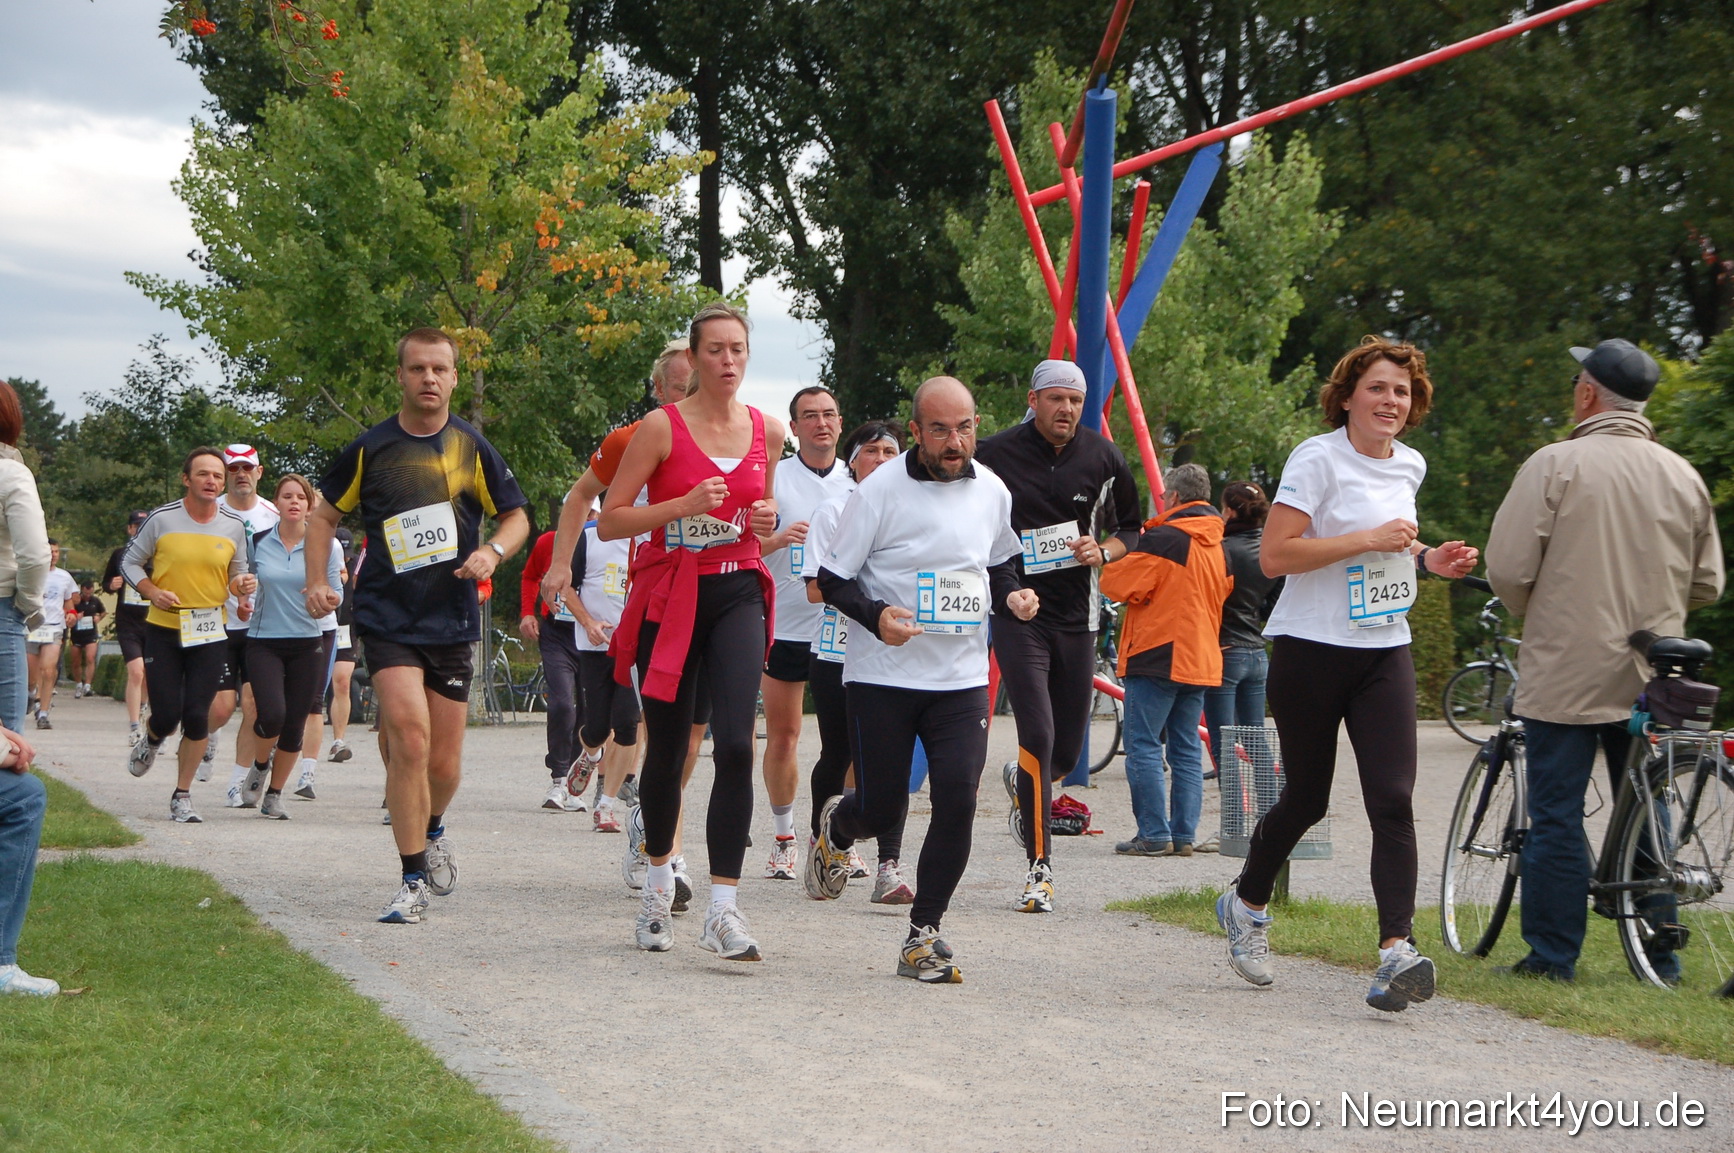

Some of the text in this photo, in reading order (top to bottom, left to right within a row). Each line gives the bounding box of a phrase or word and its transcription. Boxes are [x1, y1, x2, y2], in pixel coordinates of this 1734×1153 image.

[401, 515, 420, 529] Olaf
[414, 528, 447, 549] 290
[1036, 527, 1058, 537] Dieter
[1368, 568, 1385, 580] Irmi
[940, 577, 964, 589] Hans-
[1370, 582, 1410, 604] 2423
[941, 596, 980, 613] 2426
[196, 621, 217, 632] 432
